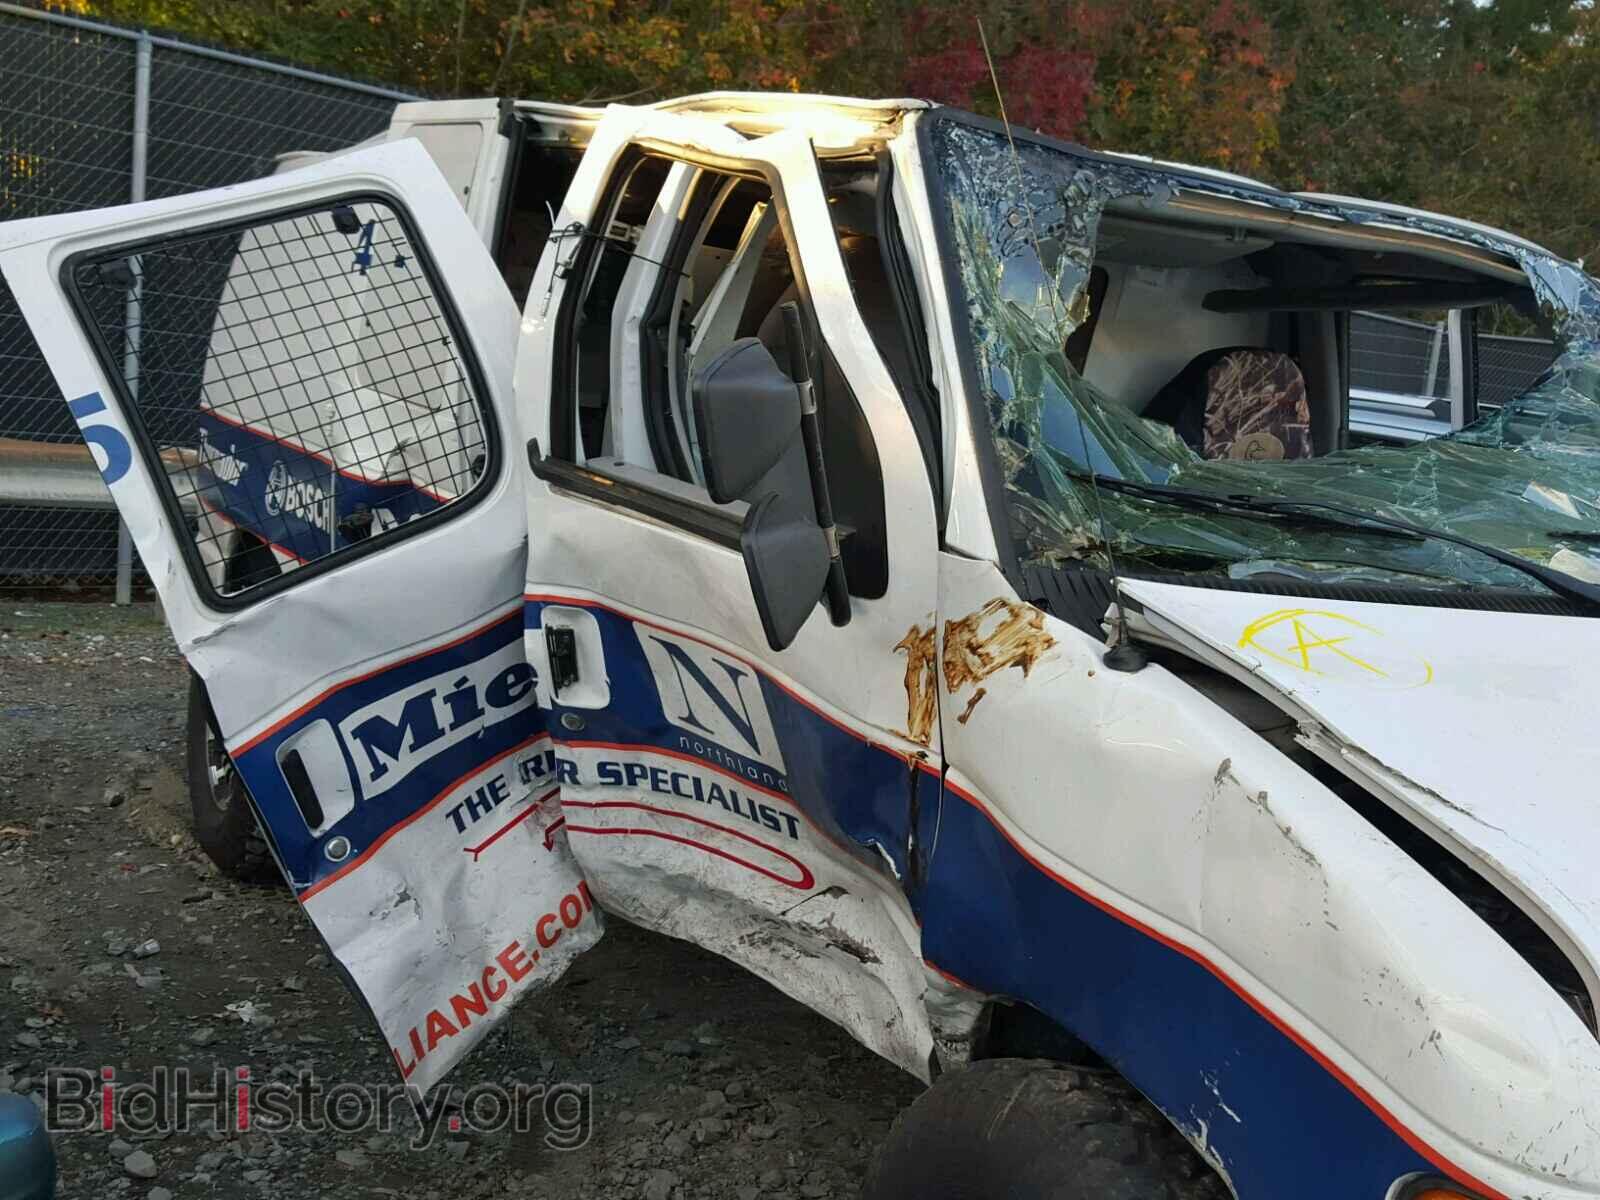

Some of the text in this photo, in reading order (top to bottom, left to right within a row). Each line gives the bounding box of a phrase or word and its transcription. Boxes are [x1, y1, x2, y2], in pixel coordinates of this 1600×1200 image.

[285, 474, 331, 535] BOSCH
[648, 634, 761, 756] N
[445, 774, 511, 835] THE
[597, 761, 800, 841] SPECIALIST
